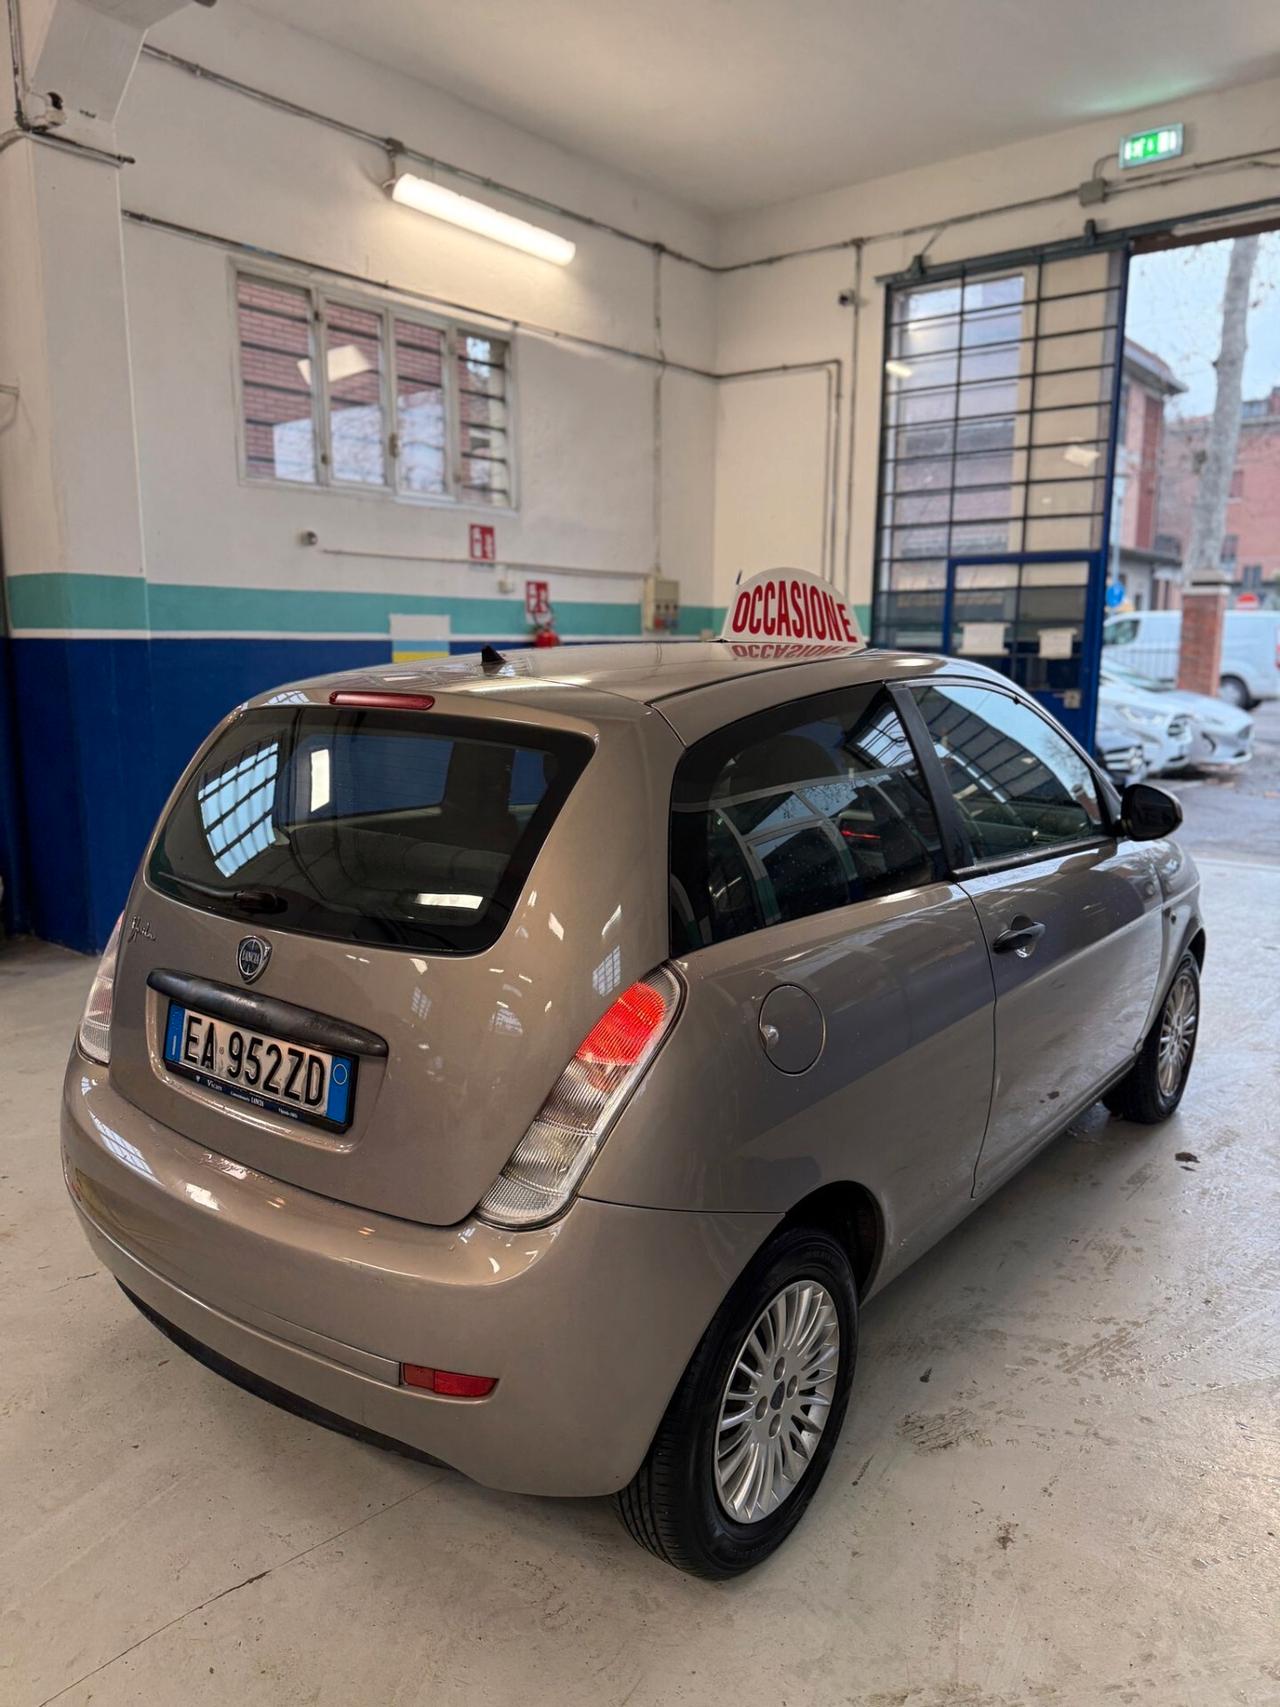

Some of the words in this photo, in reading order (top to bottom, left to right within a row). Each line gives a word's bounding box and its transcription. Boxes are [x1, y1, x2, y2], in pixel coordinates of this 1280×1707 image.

[732, 580, 858, 643] OCCASIONE
[184, 1015, 216, 1069] EA
[227, 1031, 326, 1106] 952ZD
